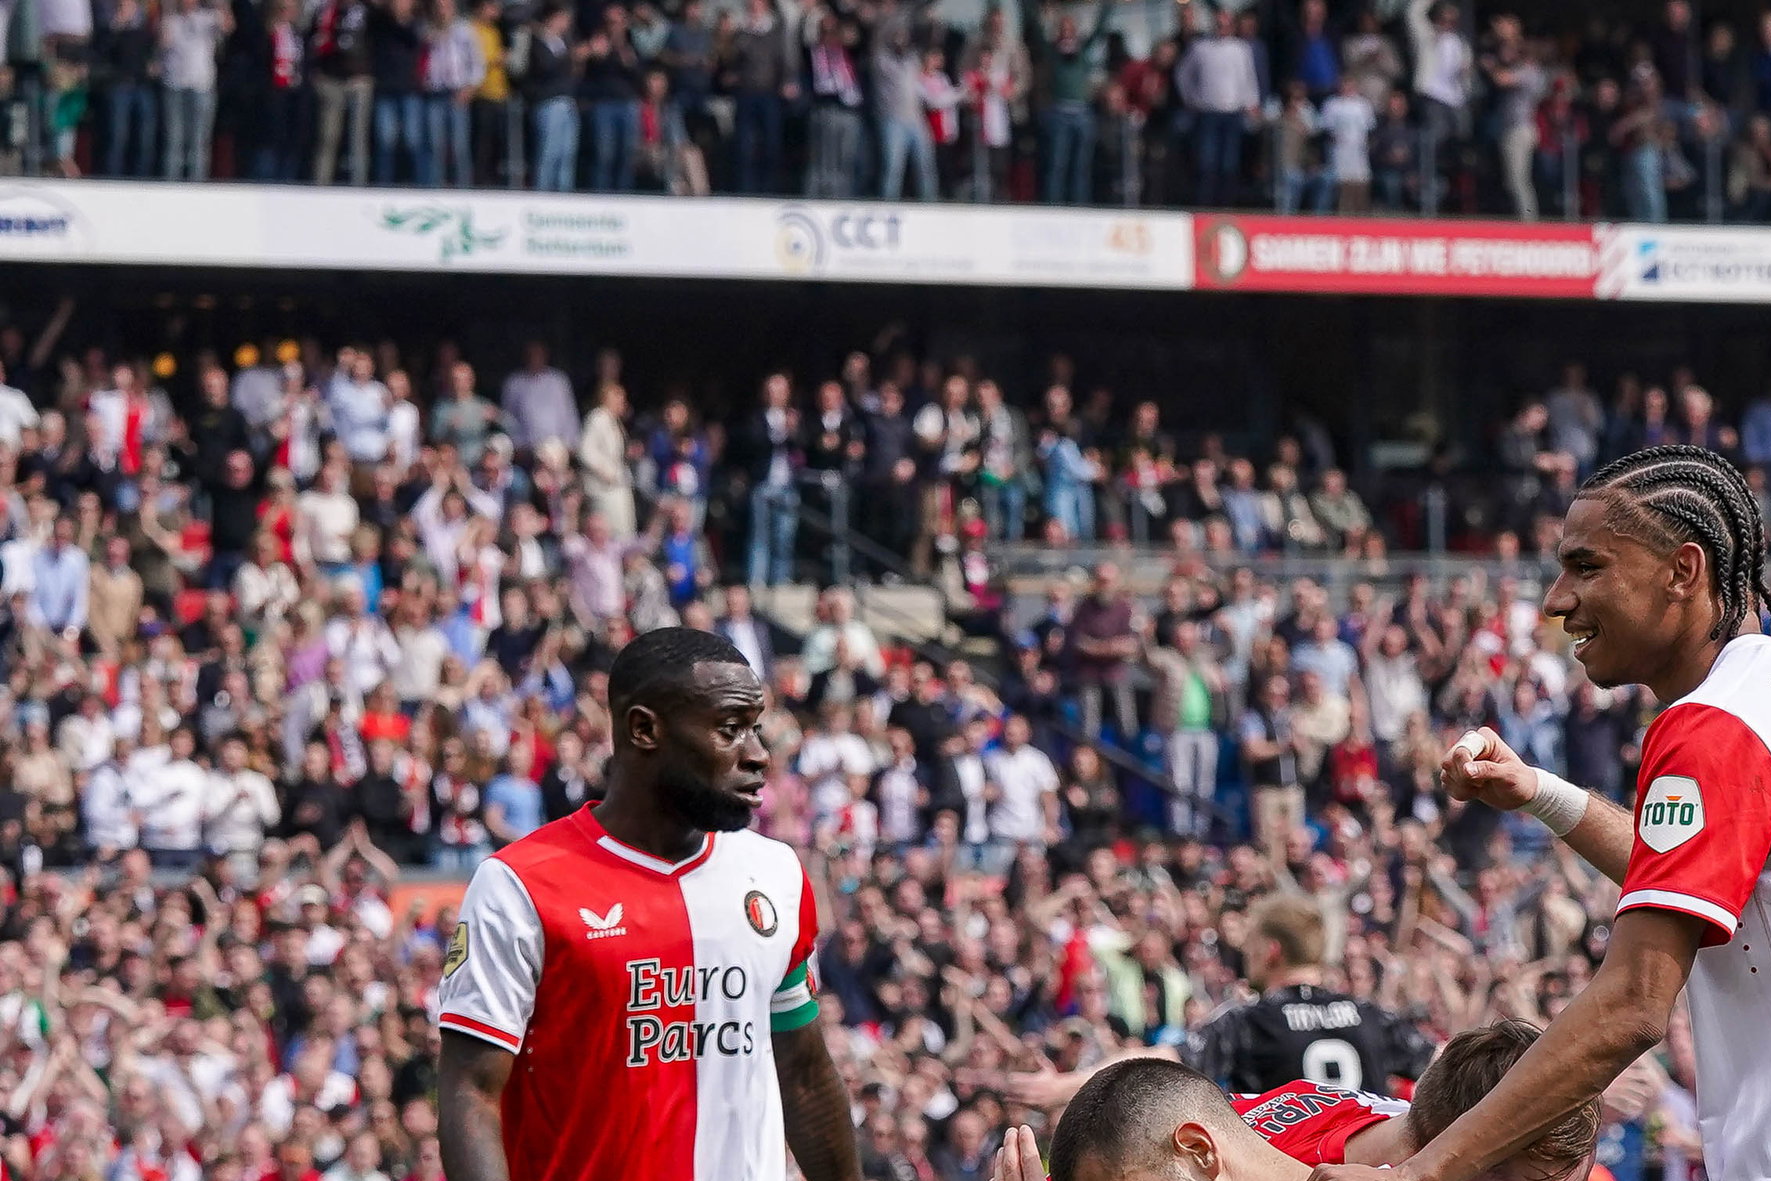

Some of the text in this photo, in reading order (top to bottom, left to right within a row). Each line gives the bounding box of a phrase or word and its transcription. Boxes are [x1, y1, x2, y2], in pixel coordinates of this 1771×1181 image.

[1645, 801, 1694, 826] TOTO
[626, 957, 746, 1012] Euro
[626, 1015, 754, 1068] Parcs
